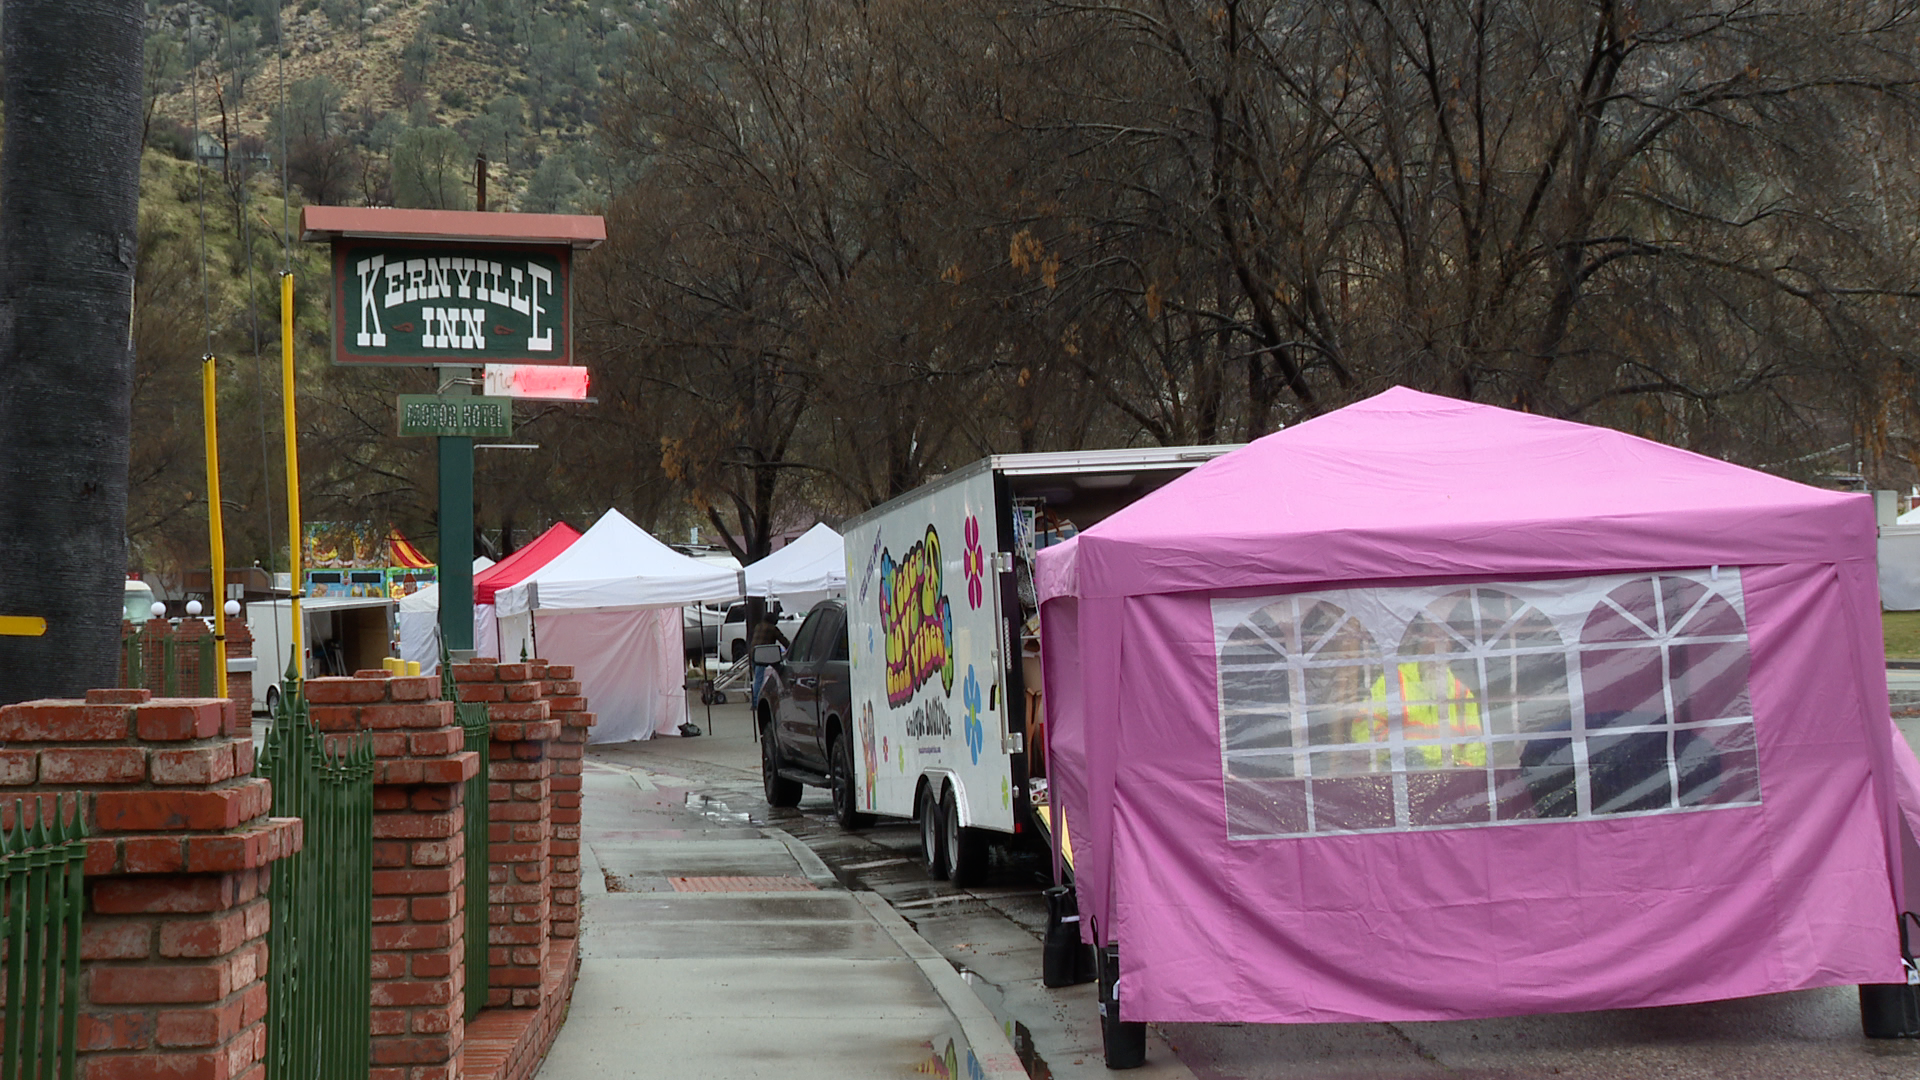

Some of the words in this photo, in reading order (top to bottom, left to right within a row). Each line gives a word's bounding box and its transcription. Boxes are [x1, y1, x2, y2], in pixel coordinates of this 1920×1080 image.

[422, 307, 485, 349] INN
[407, 403, 457, 427] MOTOR
[463, 404, 503, 427] HOTEL
[404, 582, 417, 593] STOP
